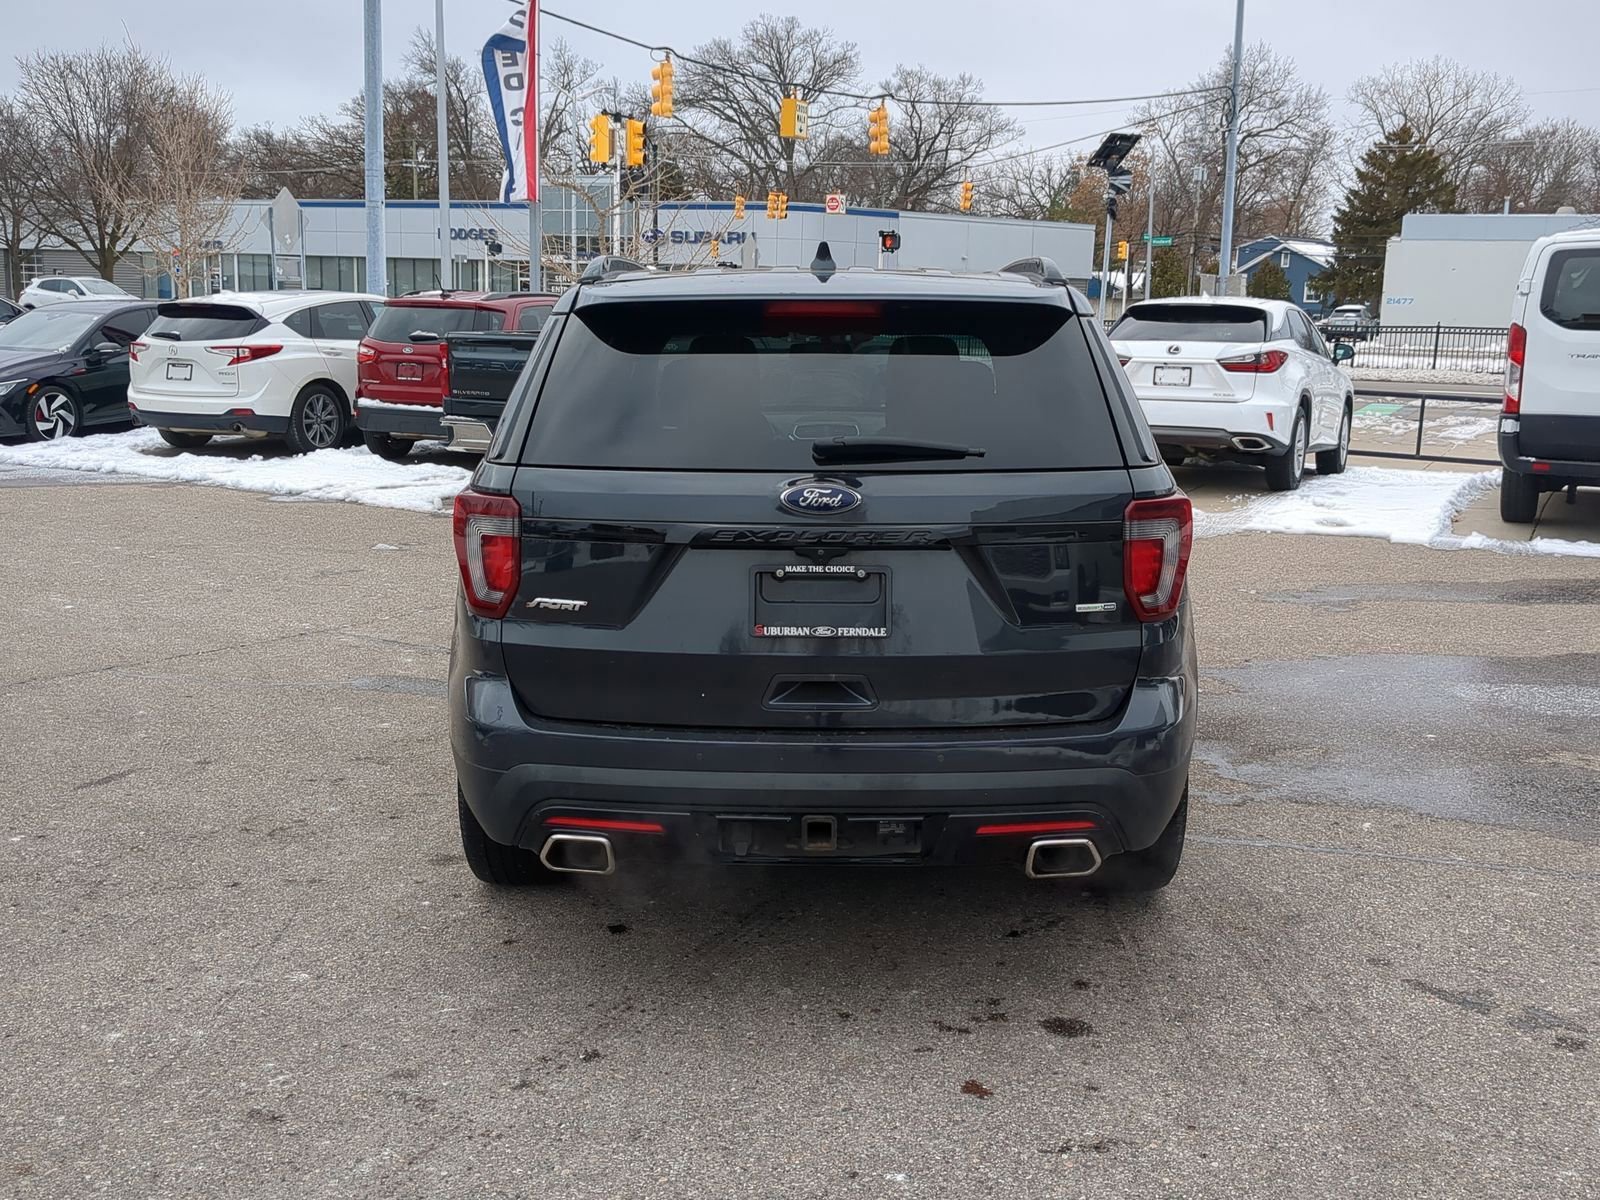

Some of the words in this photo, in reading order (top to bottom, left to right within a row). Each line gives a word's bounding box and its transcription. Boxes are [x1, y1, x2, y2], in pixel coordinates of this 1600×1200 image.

[1386, 297, 1415, 305] 21477
[799, 488, 843, 507] Ford
[712, 529, 939, 543] EXPLORER
[785, 565, 807, 573] MAKE
[808, 565, 824, 573] THE
[825, 565, 855, 573] CHOICE
[525, 597, 588, 611] SPORT
[754, 624, 810, 636] SUBURBAN
[837, 627, 887, 637] FERNDALE
